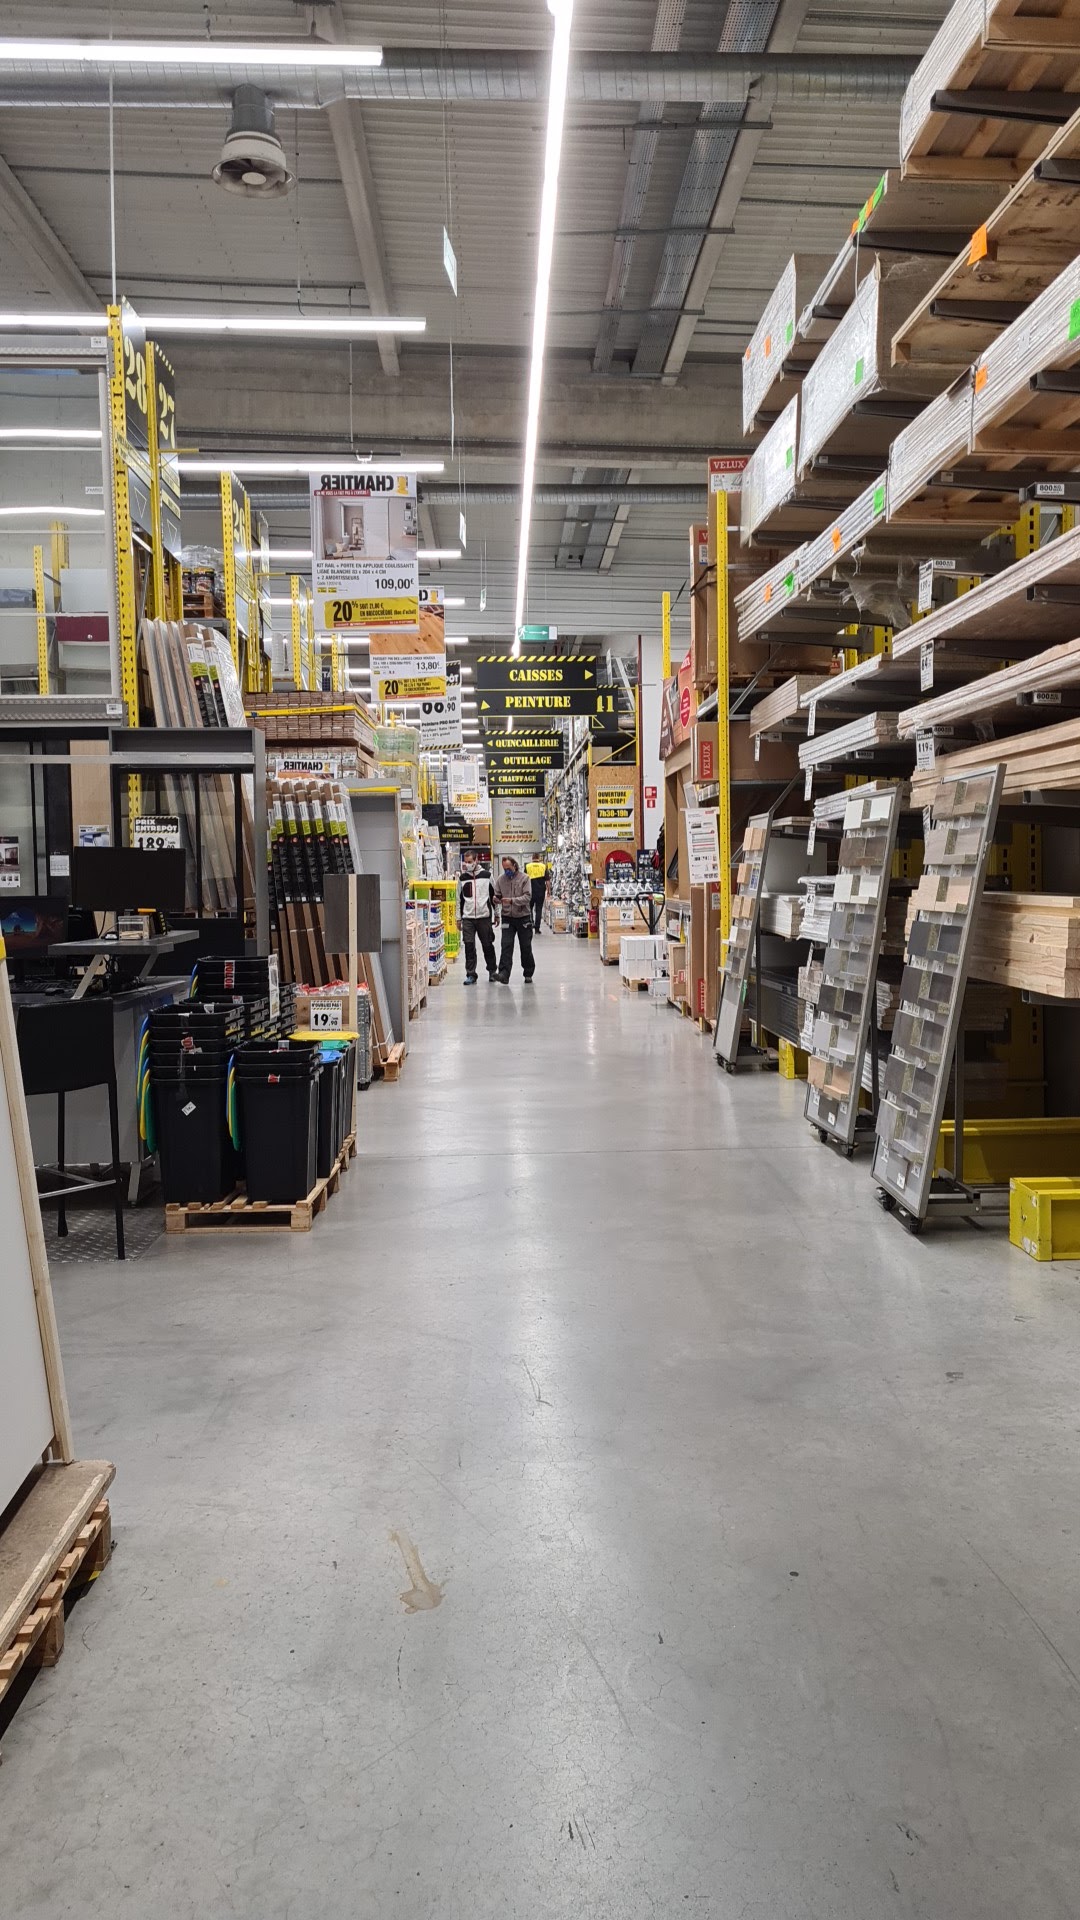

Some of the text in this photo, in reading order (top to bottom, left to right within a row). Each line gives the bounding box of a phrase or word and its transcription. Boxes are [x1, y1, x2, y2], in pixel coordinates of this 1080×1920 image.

[509, 669, 563, 681] CAISSES
[505, 696, 571, 708] PEINTURE
[596, 695, 614, 712] 41
[495, 739, 559, 747] QUINCAILLERIE
[504, 756, 552, 765] OUTILLAGE
